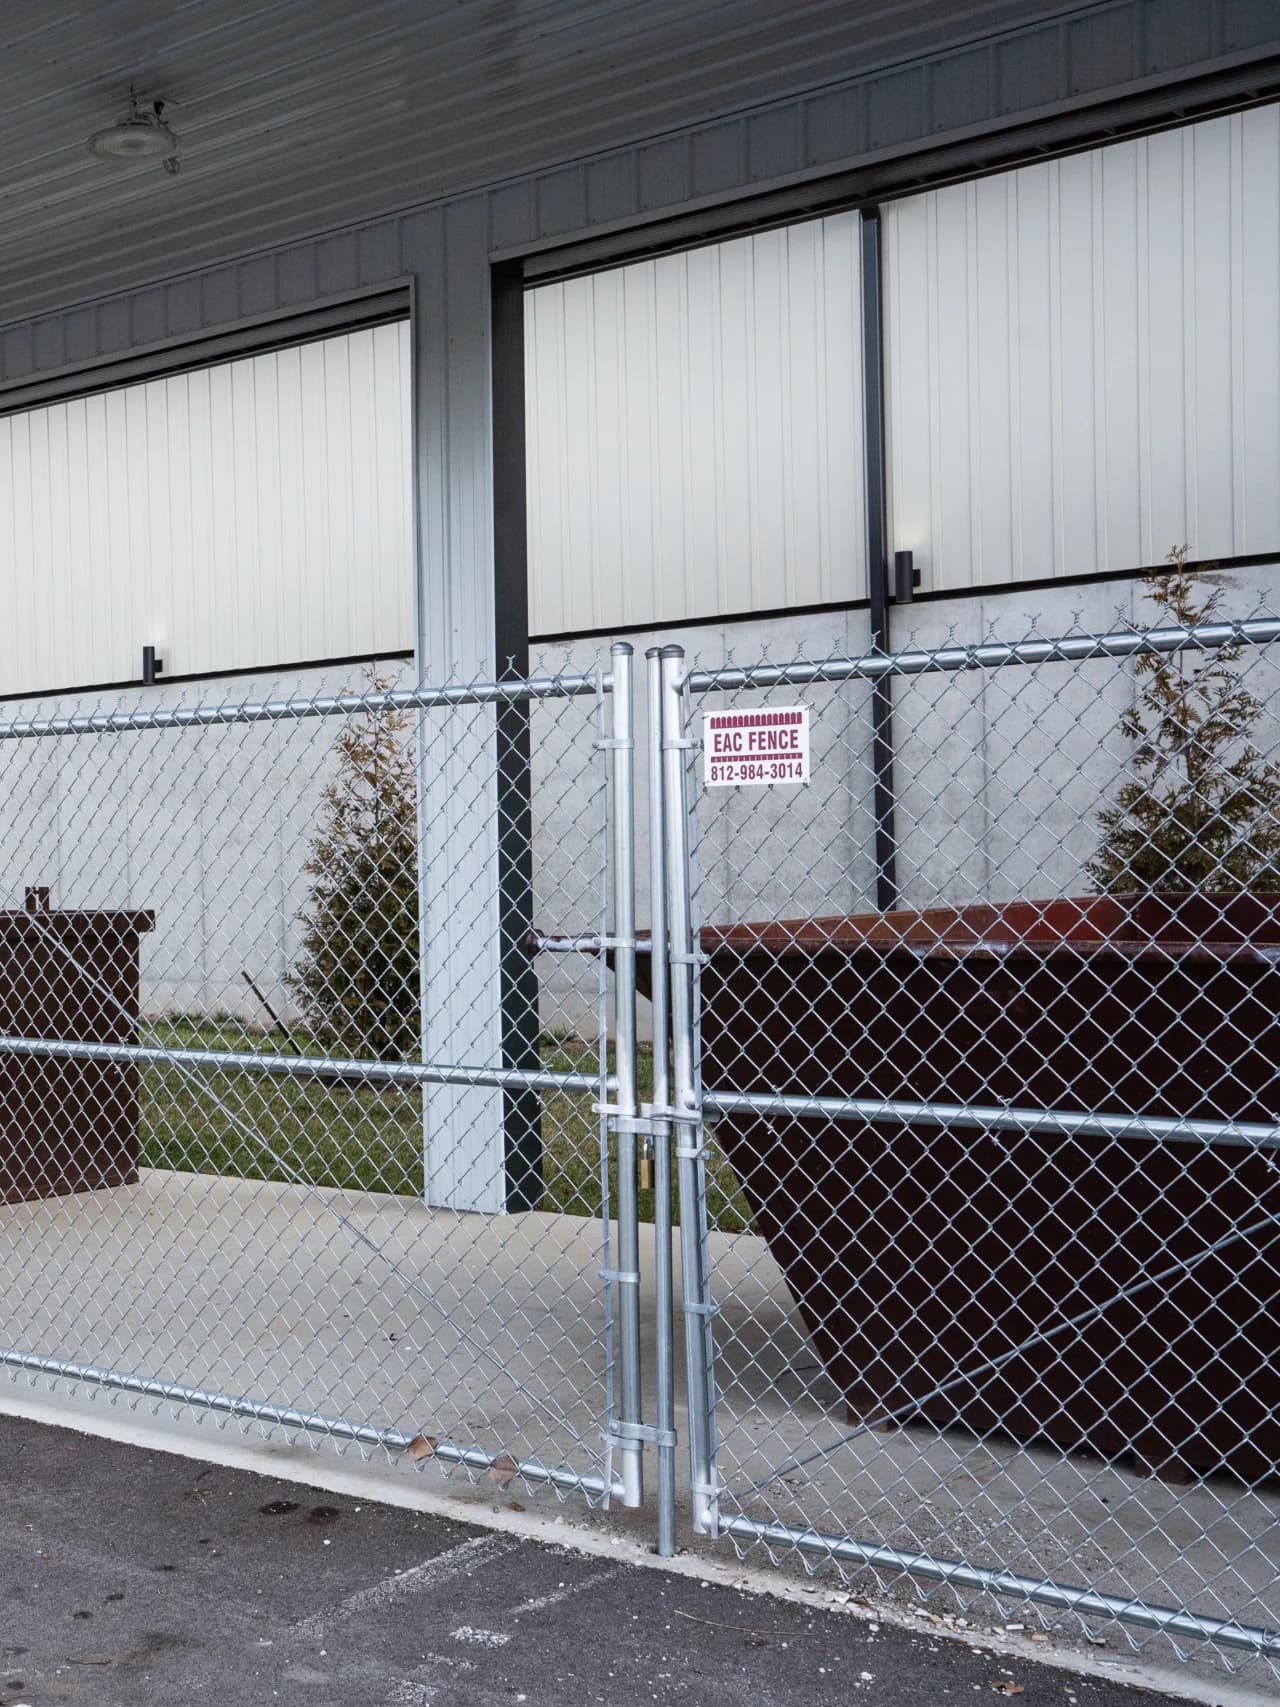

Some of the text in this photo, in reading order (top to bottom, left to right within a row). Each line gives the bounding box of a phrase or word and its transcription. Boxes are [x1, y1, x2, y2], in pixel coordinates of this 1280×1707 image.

[714, 729, 798, 752] EAC FENCE
[711, 762, 803, 781] 812-984-3014
